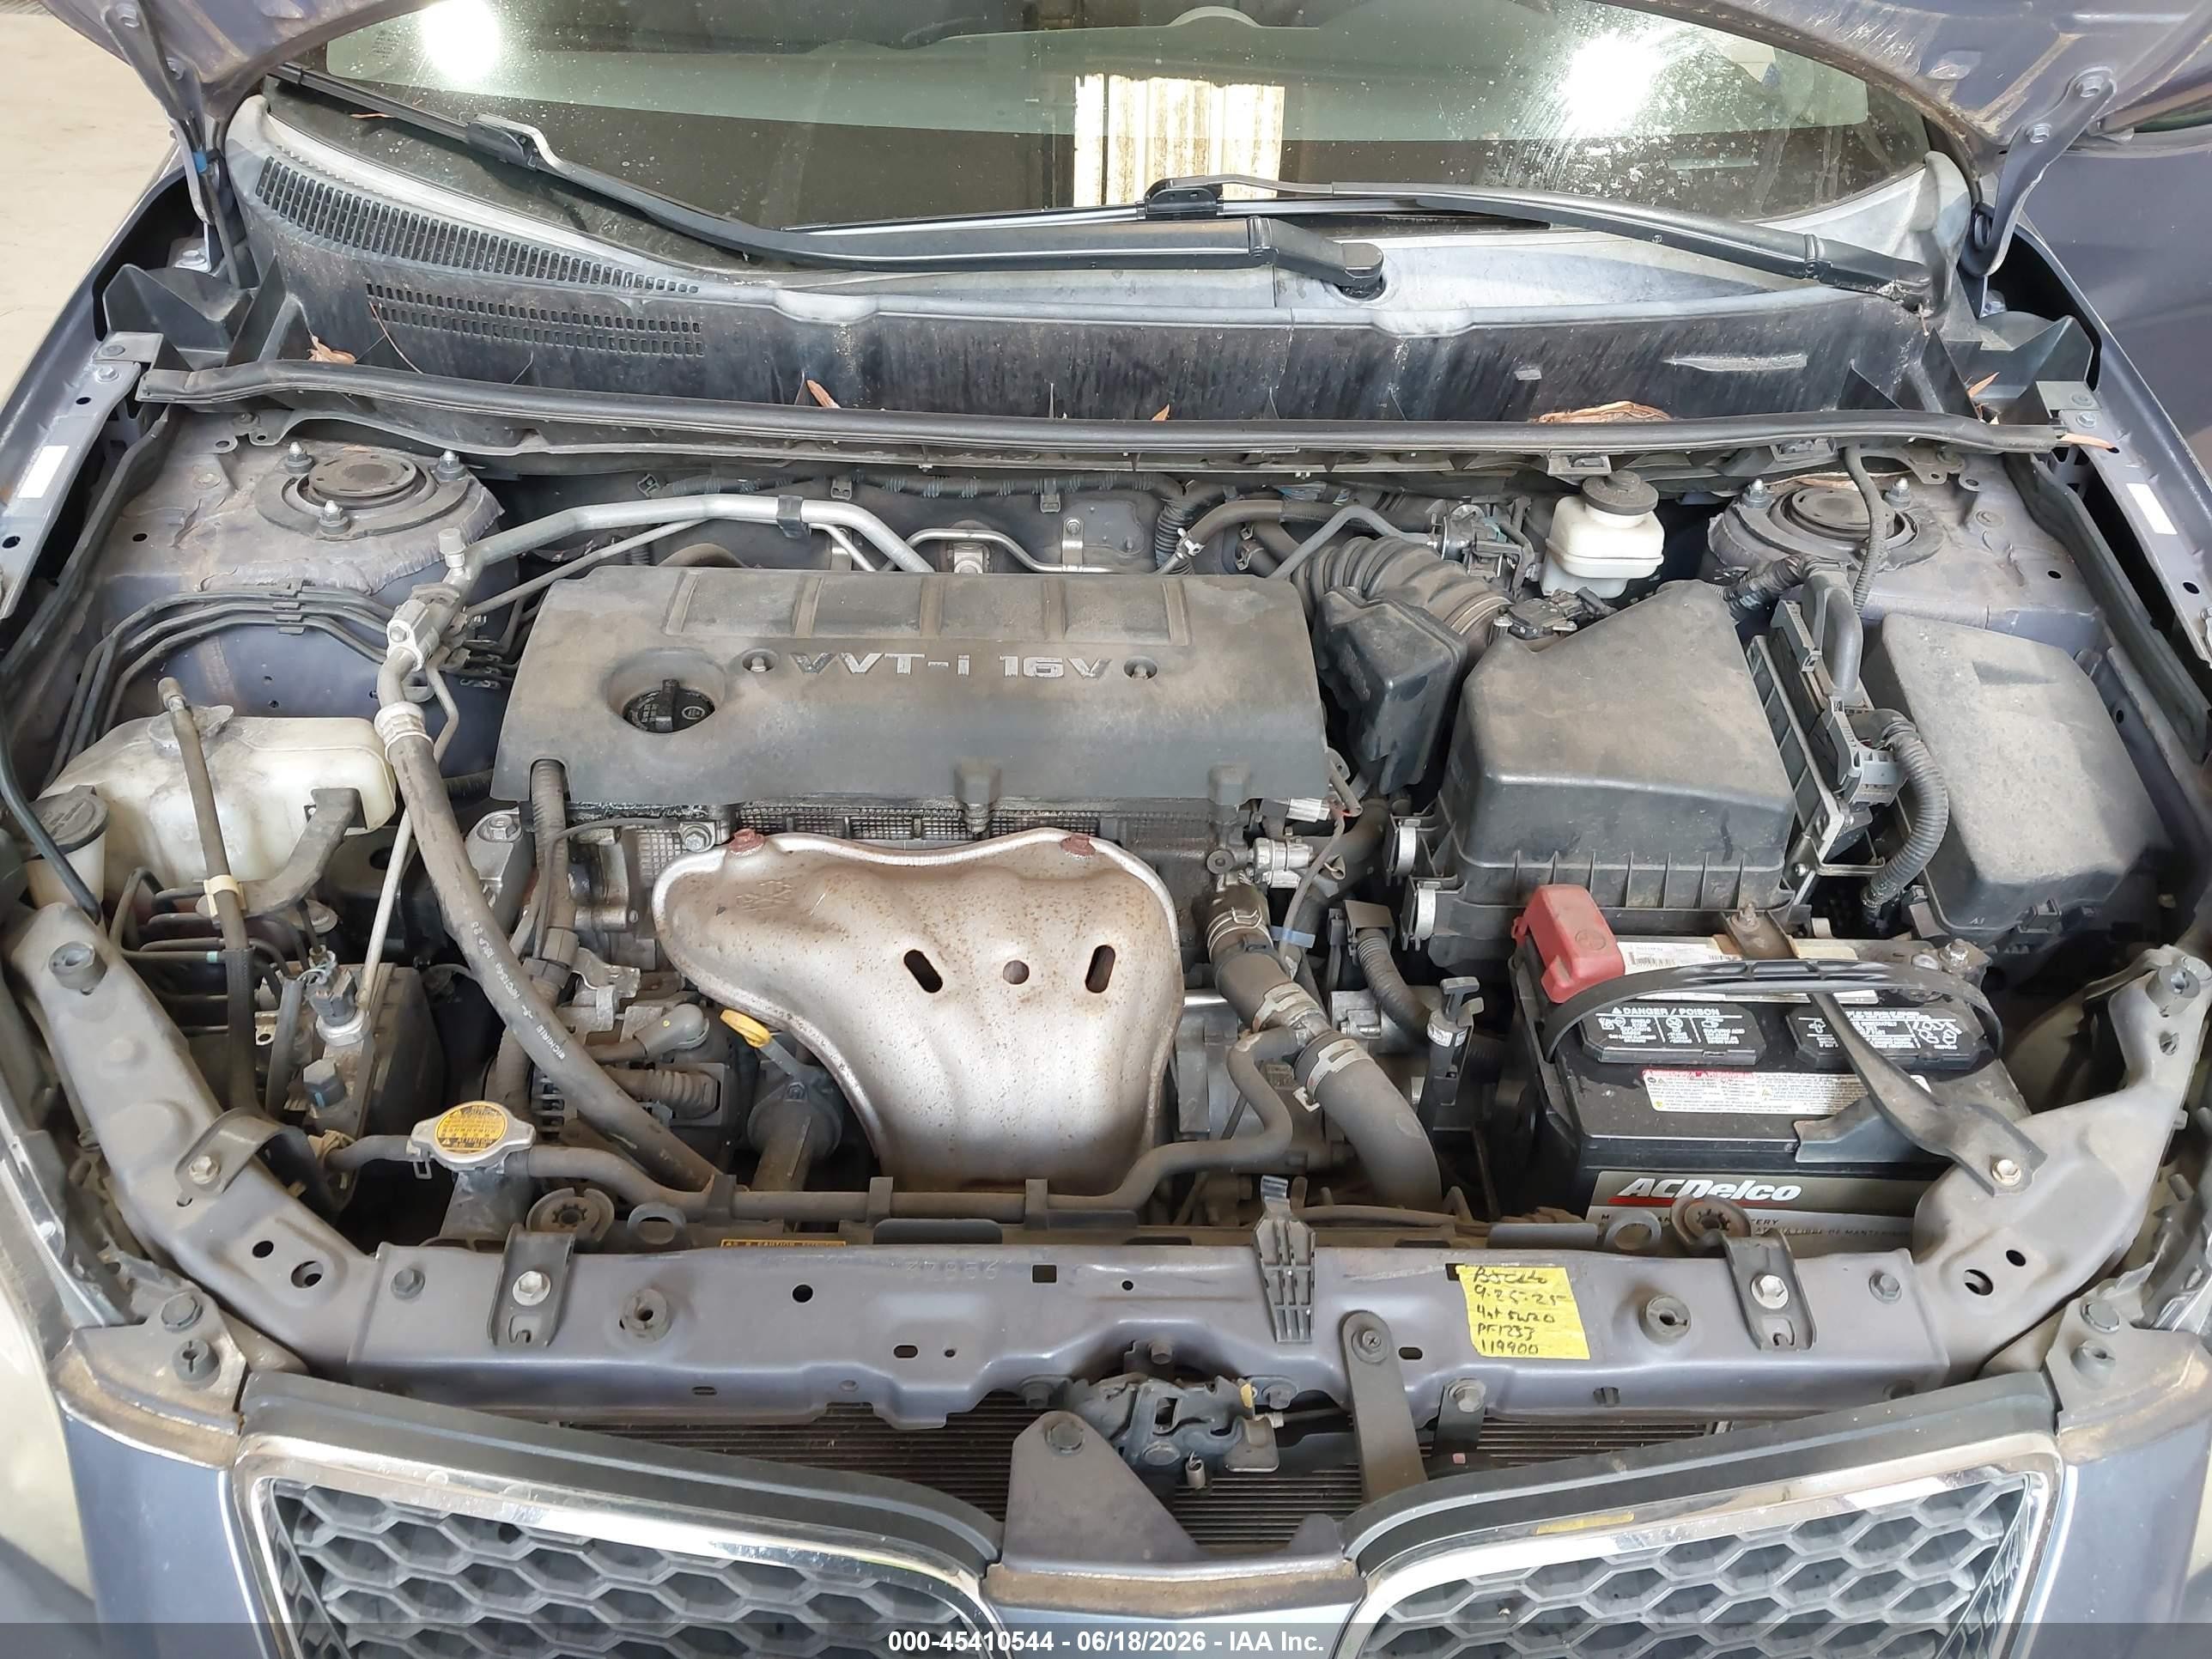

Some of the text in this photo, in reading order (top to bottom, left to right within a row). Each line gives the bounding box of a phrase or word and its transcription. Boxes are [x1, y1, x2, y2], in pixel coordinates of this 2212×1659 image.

[999, 655, 1112, 679] 16V
[1622, 1007, 1668, 1016] DANGER
[1481, 1339, 1539, 1355] 119900
